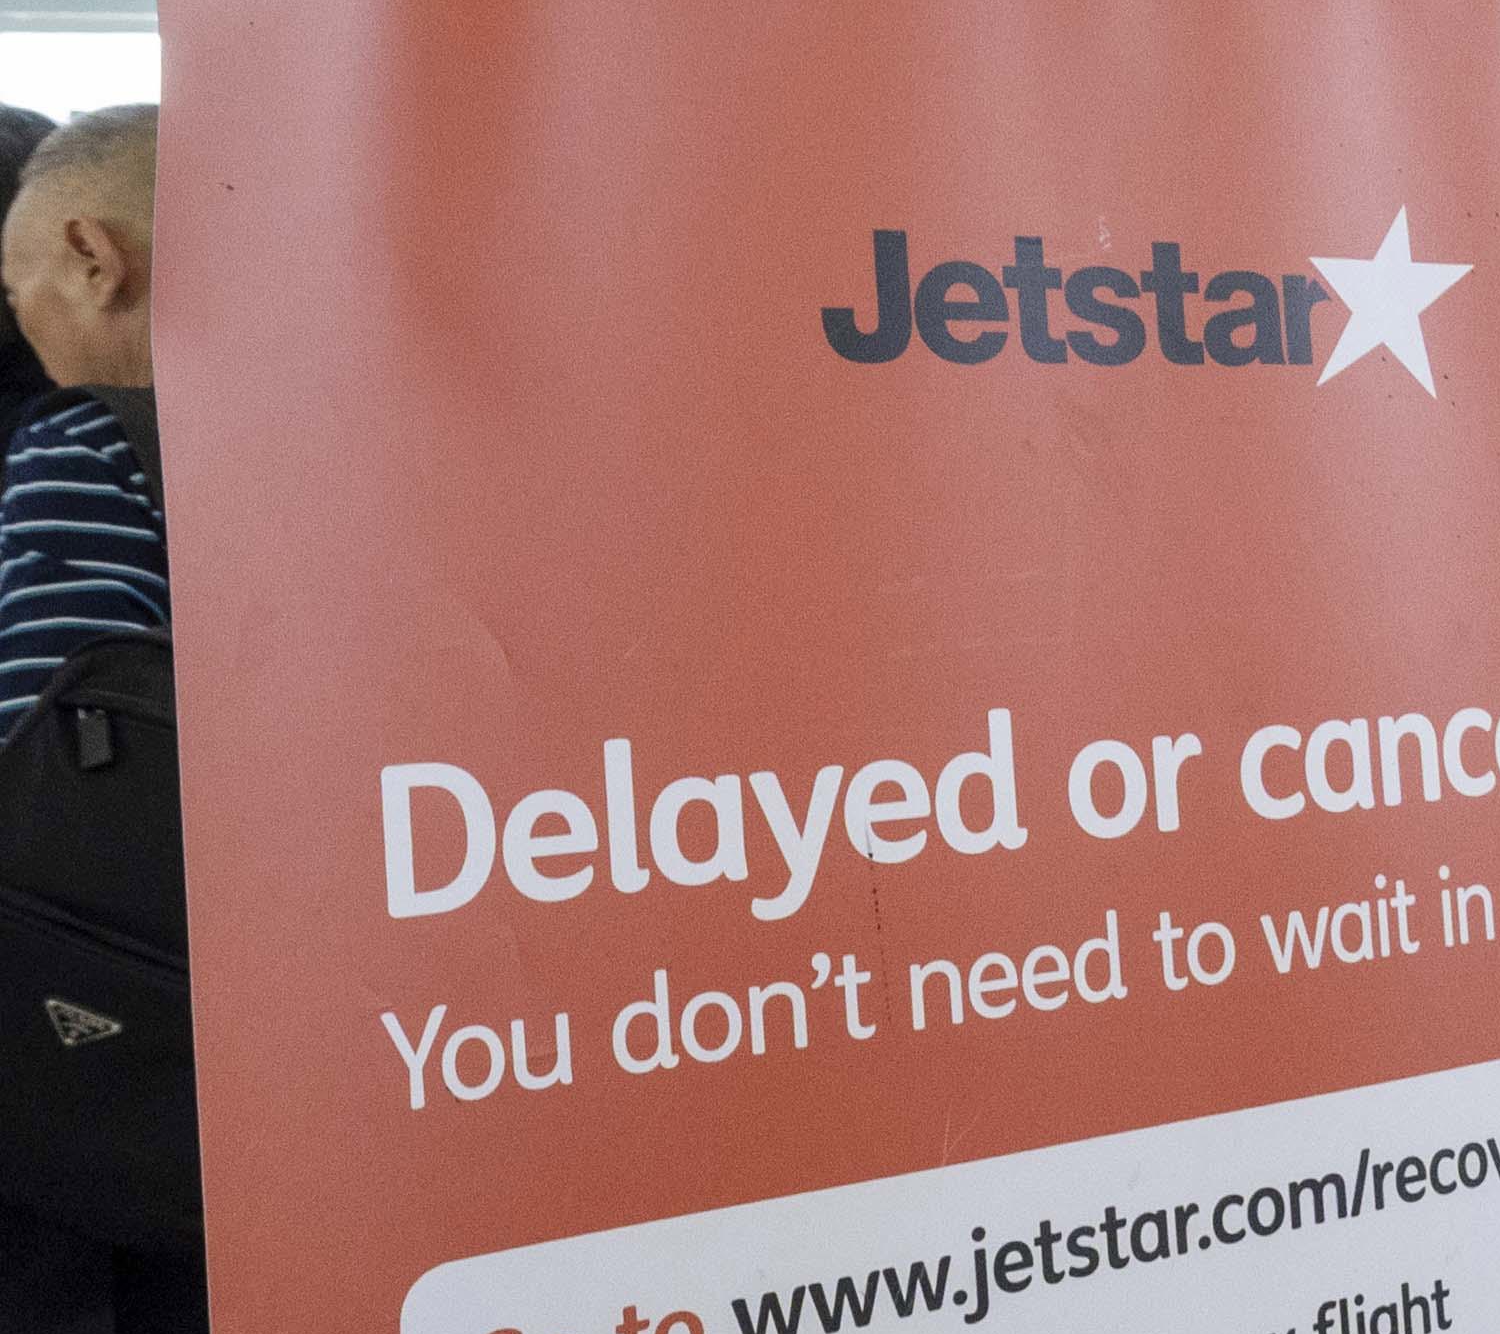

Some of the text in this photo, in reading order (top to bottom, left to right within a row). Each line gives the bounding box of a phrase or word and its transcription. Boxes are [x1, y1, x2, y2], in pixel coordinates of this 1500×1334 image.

[821, 229, 1329, 368] Jetstar
[380, 709, 1028, 921] Delayed
[1066, 732, 1203, 839] or
[381, 1004, 573, 1110] You
[610, 953, 876, 1076] don’t
[909, 910, 1129, 1030] need
[1152, 908, 1236, 990] to
[1261, 875, 1420, 976] wait
[1438, 865, 1496, 949] in
